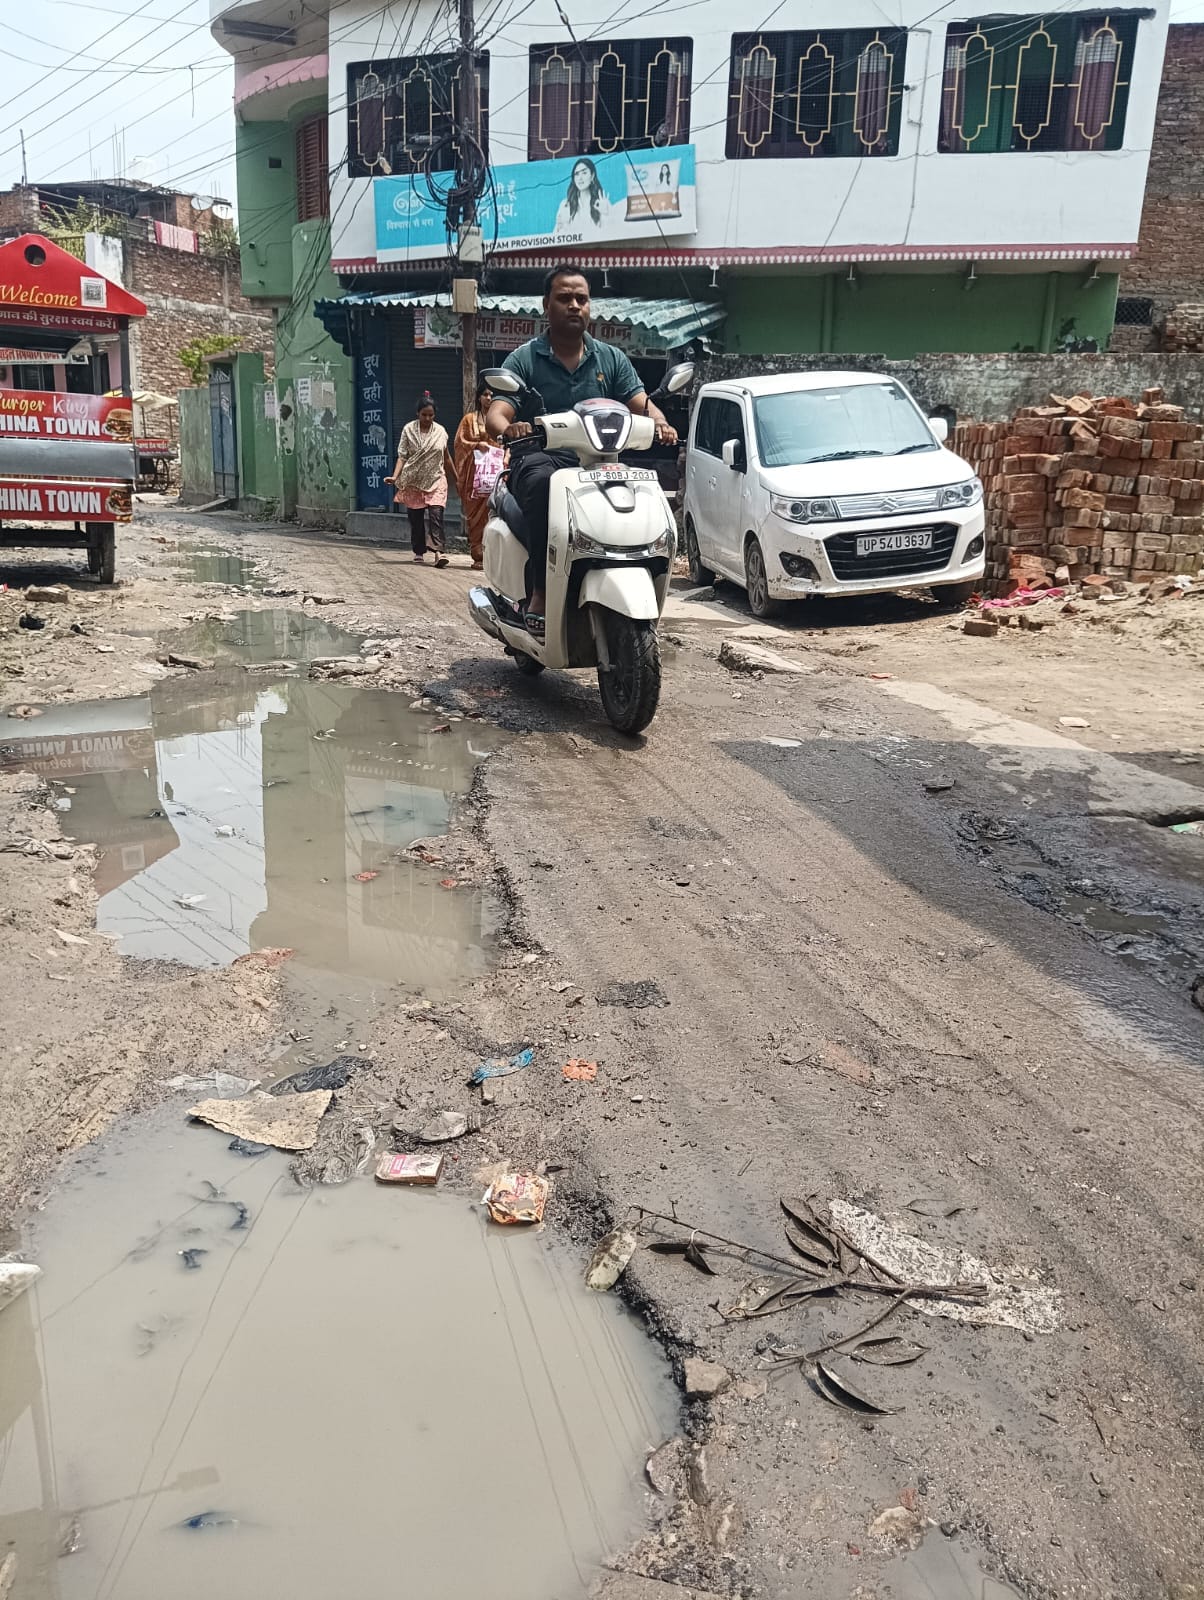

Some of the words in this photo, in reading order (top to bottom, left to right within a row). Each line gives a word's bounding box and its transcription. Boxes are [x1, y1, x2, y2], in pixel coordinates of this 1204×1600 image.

[511, 237, 555, 248] PROVISION
[557, 233, 583, 243] STORE
[0, 284, 78, 307] Welcome
[362, 381, 383, 402] दही
[0, 392, 46, 416] urger
[0, 414, 40, 433] HINA
[43, 416, 101, 437] TOWN
[366, 473, 381, 489] घी
[0, 488, 43, 512] HINA
[45, 489, 102, 514] TOWN
[864, 539, 878, 551] UP
[879, 537, 893, 550] 54
[895, 535, 902, 549] U
[904, 533, 931, 548] 3637
